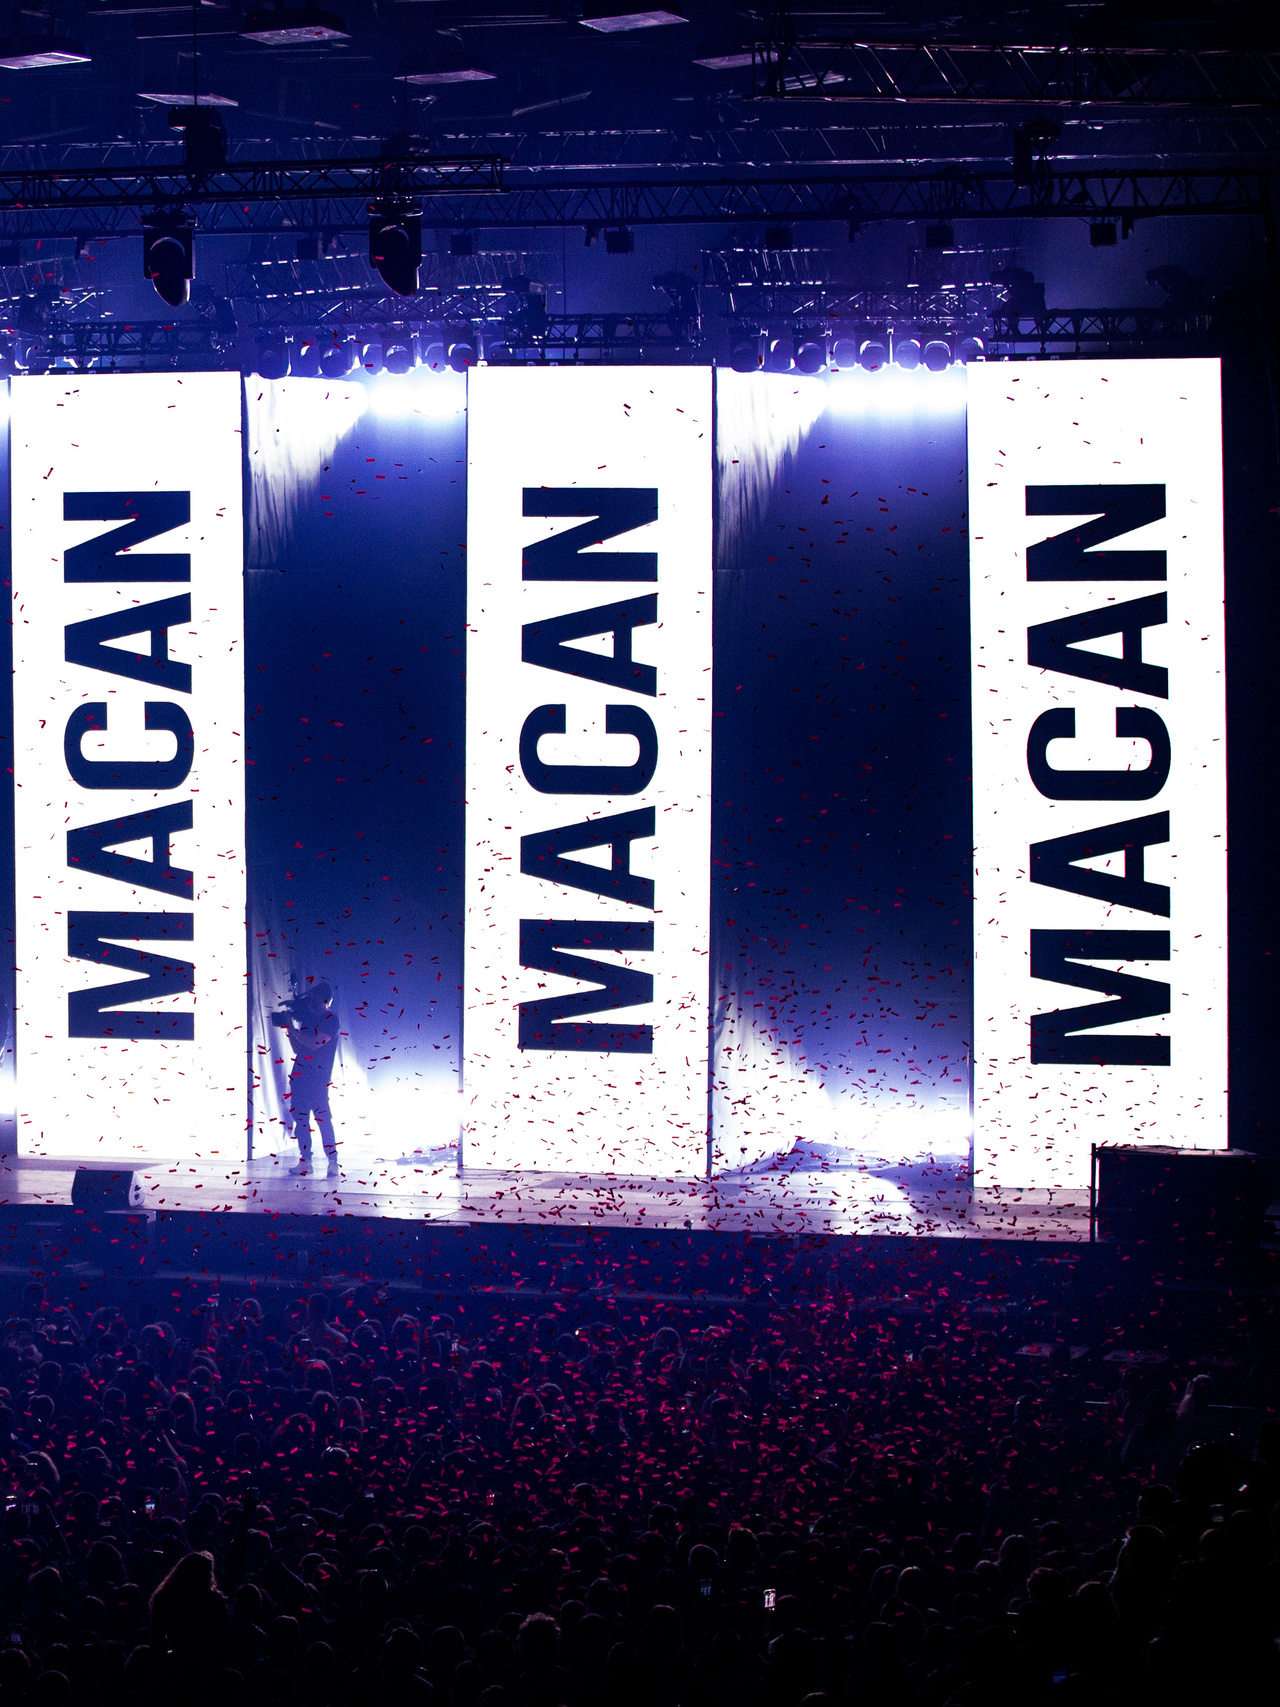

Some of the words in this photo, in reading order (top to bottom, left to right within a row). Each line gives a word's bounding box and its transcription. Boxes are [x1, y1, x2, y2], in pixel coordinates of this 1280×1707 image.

[63, 491, 195, 1040] MACAN
[518, 486, 659, 1055] MACAN
[1026, 484, 1171, 1066] MACAN
